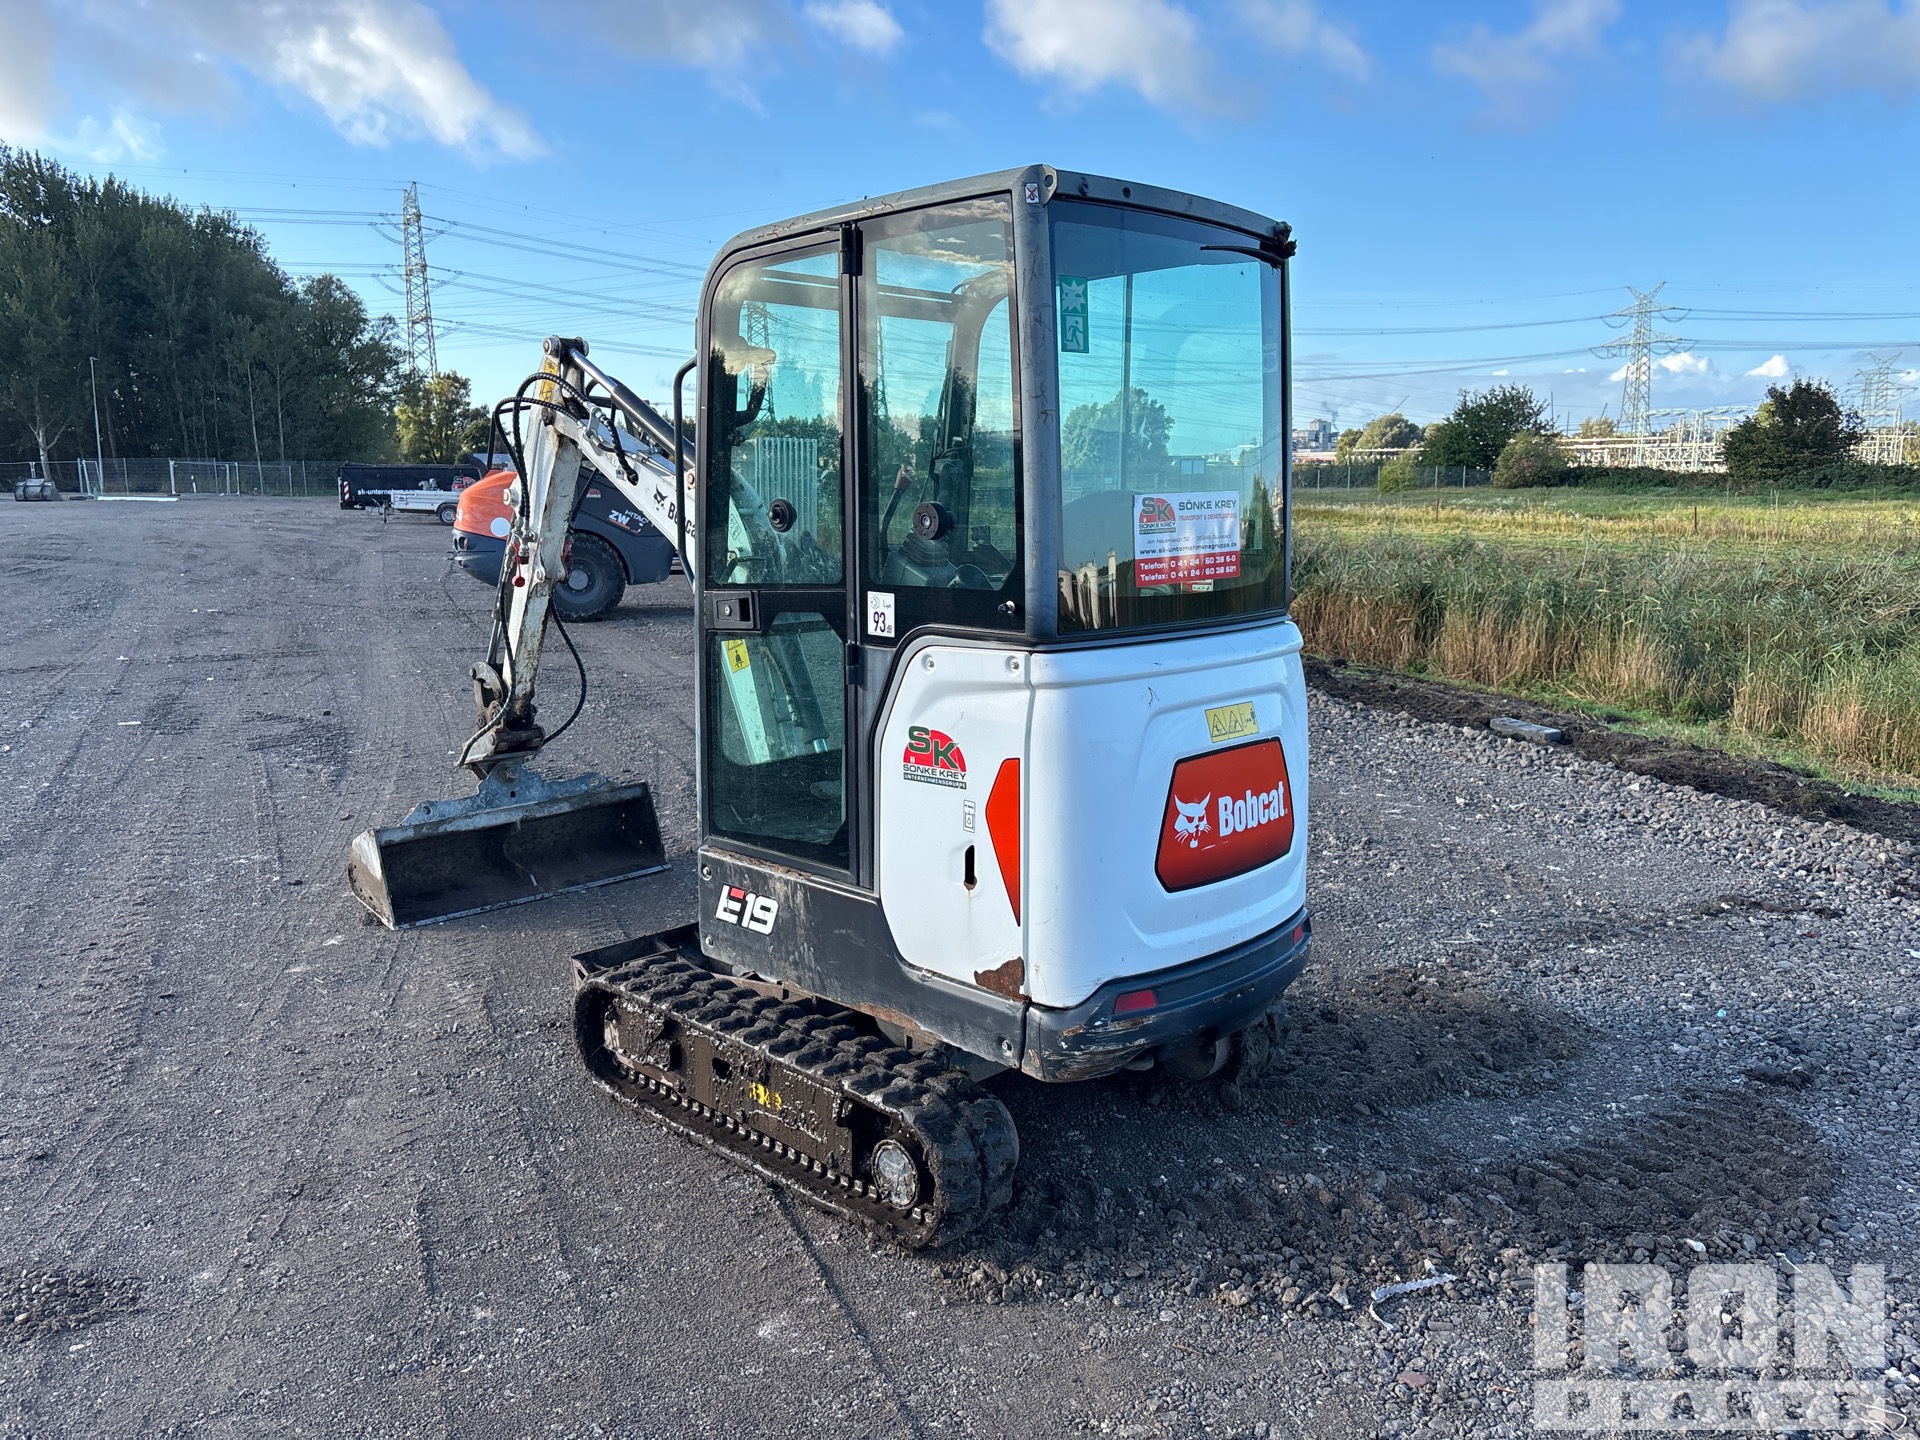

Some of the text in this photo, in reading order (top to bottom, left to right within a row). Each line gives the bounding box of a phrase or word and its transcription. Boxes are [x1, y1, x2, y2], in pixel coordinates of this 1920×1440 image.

[1141, 497, 1174, 521] SK
[1178, 500, 1237, 511] SÖNKE KREY
[1140, 561, 1168, 571] Telefon:
[1170, 560, 1176, 568] 0
[1177, 559, 1187, 567] 41
[1189, 558, 1200, 566] 24
[1140, 573, 1168, 582] Telefax:
[1178, 570, 1188, 578] 41
[1190, 569, 1200, 577] 24
[873, 610, 893, 634] 93 dB
[908, 725, 959, 769] SK
[903, 773, 967, 789] UNTERNEHMENSGRUPPE
[938, 769, 967, 781] KREY
[1217, 780, 1285, 838] Bobcat
[715, 884, 779, 935] E19
